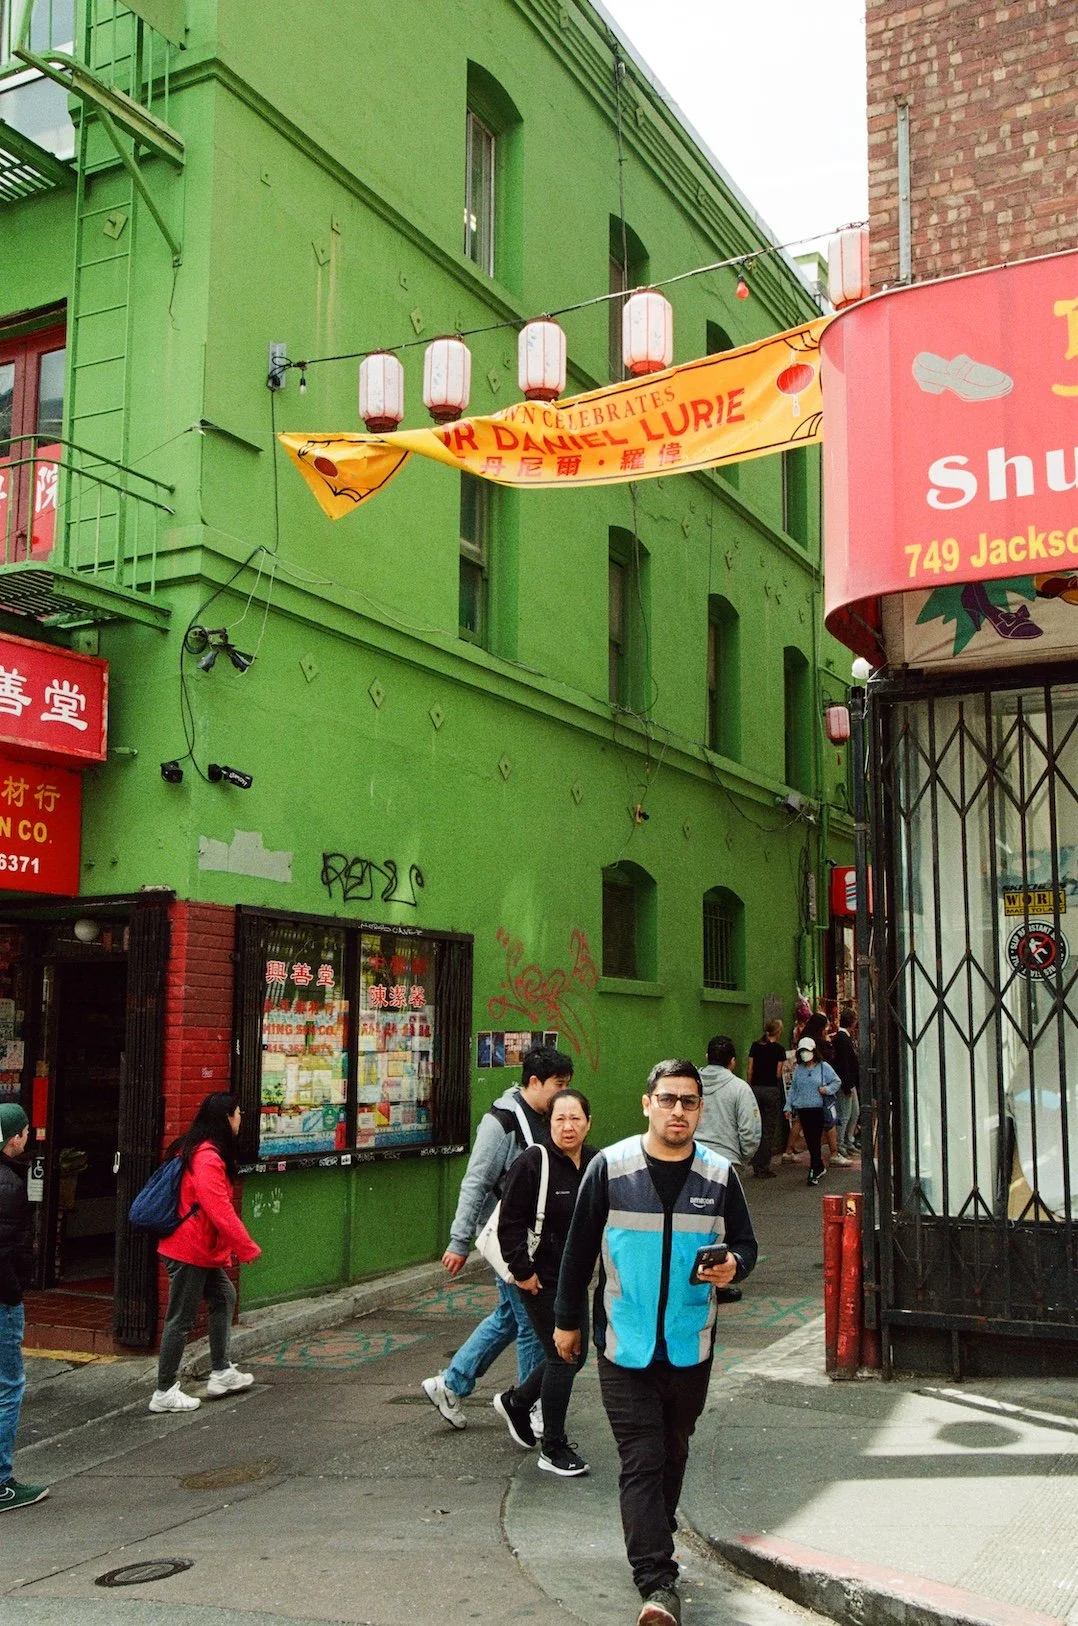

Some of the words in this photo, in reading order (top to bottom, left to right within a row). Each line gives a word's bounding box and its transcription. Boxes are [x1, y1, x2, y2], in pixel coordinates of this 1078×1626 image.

[492, 425, 628, 455] DANIEL
[640, 387, 745, 441] LURIE
[543, 385, 675, 430] CELEBRATES
[457, 443, 682, 476] 丹尼爾·羅偉
[904, 538, 959, 577] 749
[1, 776, 60, 812] 材行
[18, 820, 53, 844] CO.
[265, 960, 336, 987] 興善堂
[690, 1197, 715, 1205] amazon
